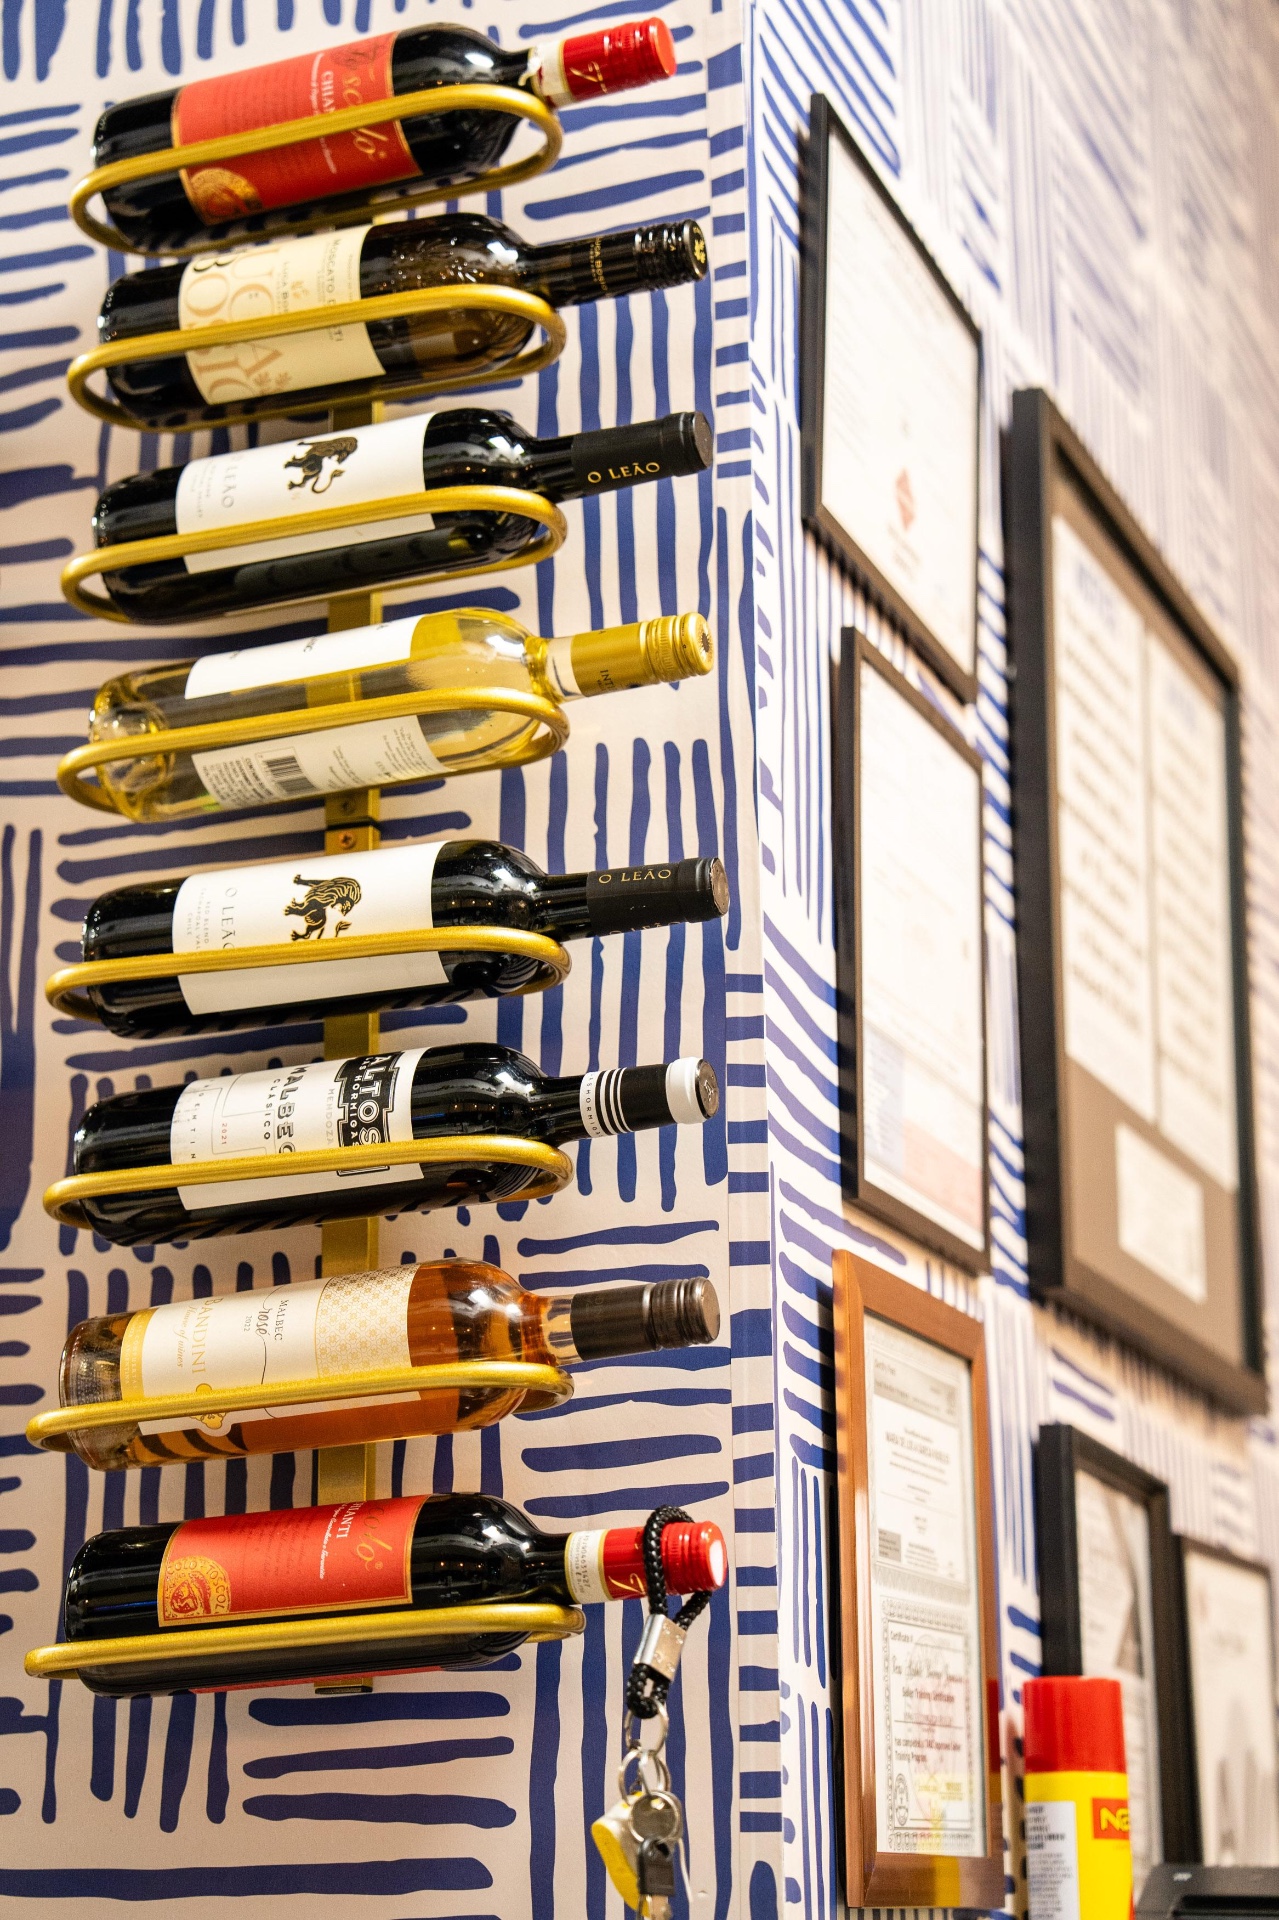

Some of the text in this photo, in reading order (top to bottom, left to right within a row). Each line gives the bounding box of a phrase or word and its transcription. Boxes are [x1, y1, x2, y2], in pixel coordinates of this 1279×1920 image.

[586, 462, 660, 483] O LEÃO
[598, 868, 673, 884] O LEÃO
[225, 887, 238, 898] O
[356, 1055, 393, 1147] ALTOS
[323, 1088, 336, 1146] MENDOZA
[220, 1122, 228, 1145] 2021
[243, 1315, 253, 1332] 2022
[254, 1306, 271, 1337] rosé
[274, 1299, 290, 1342] MALBEC
[192, 1297, 225, 1374] BANDINI
[176, 1340, 188, 1368] wines
